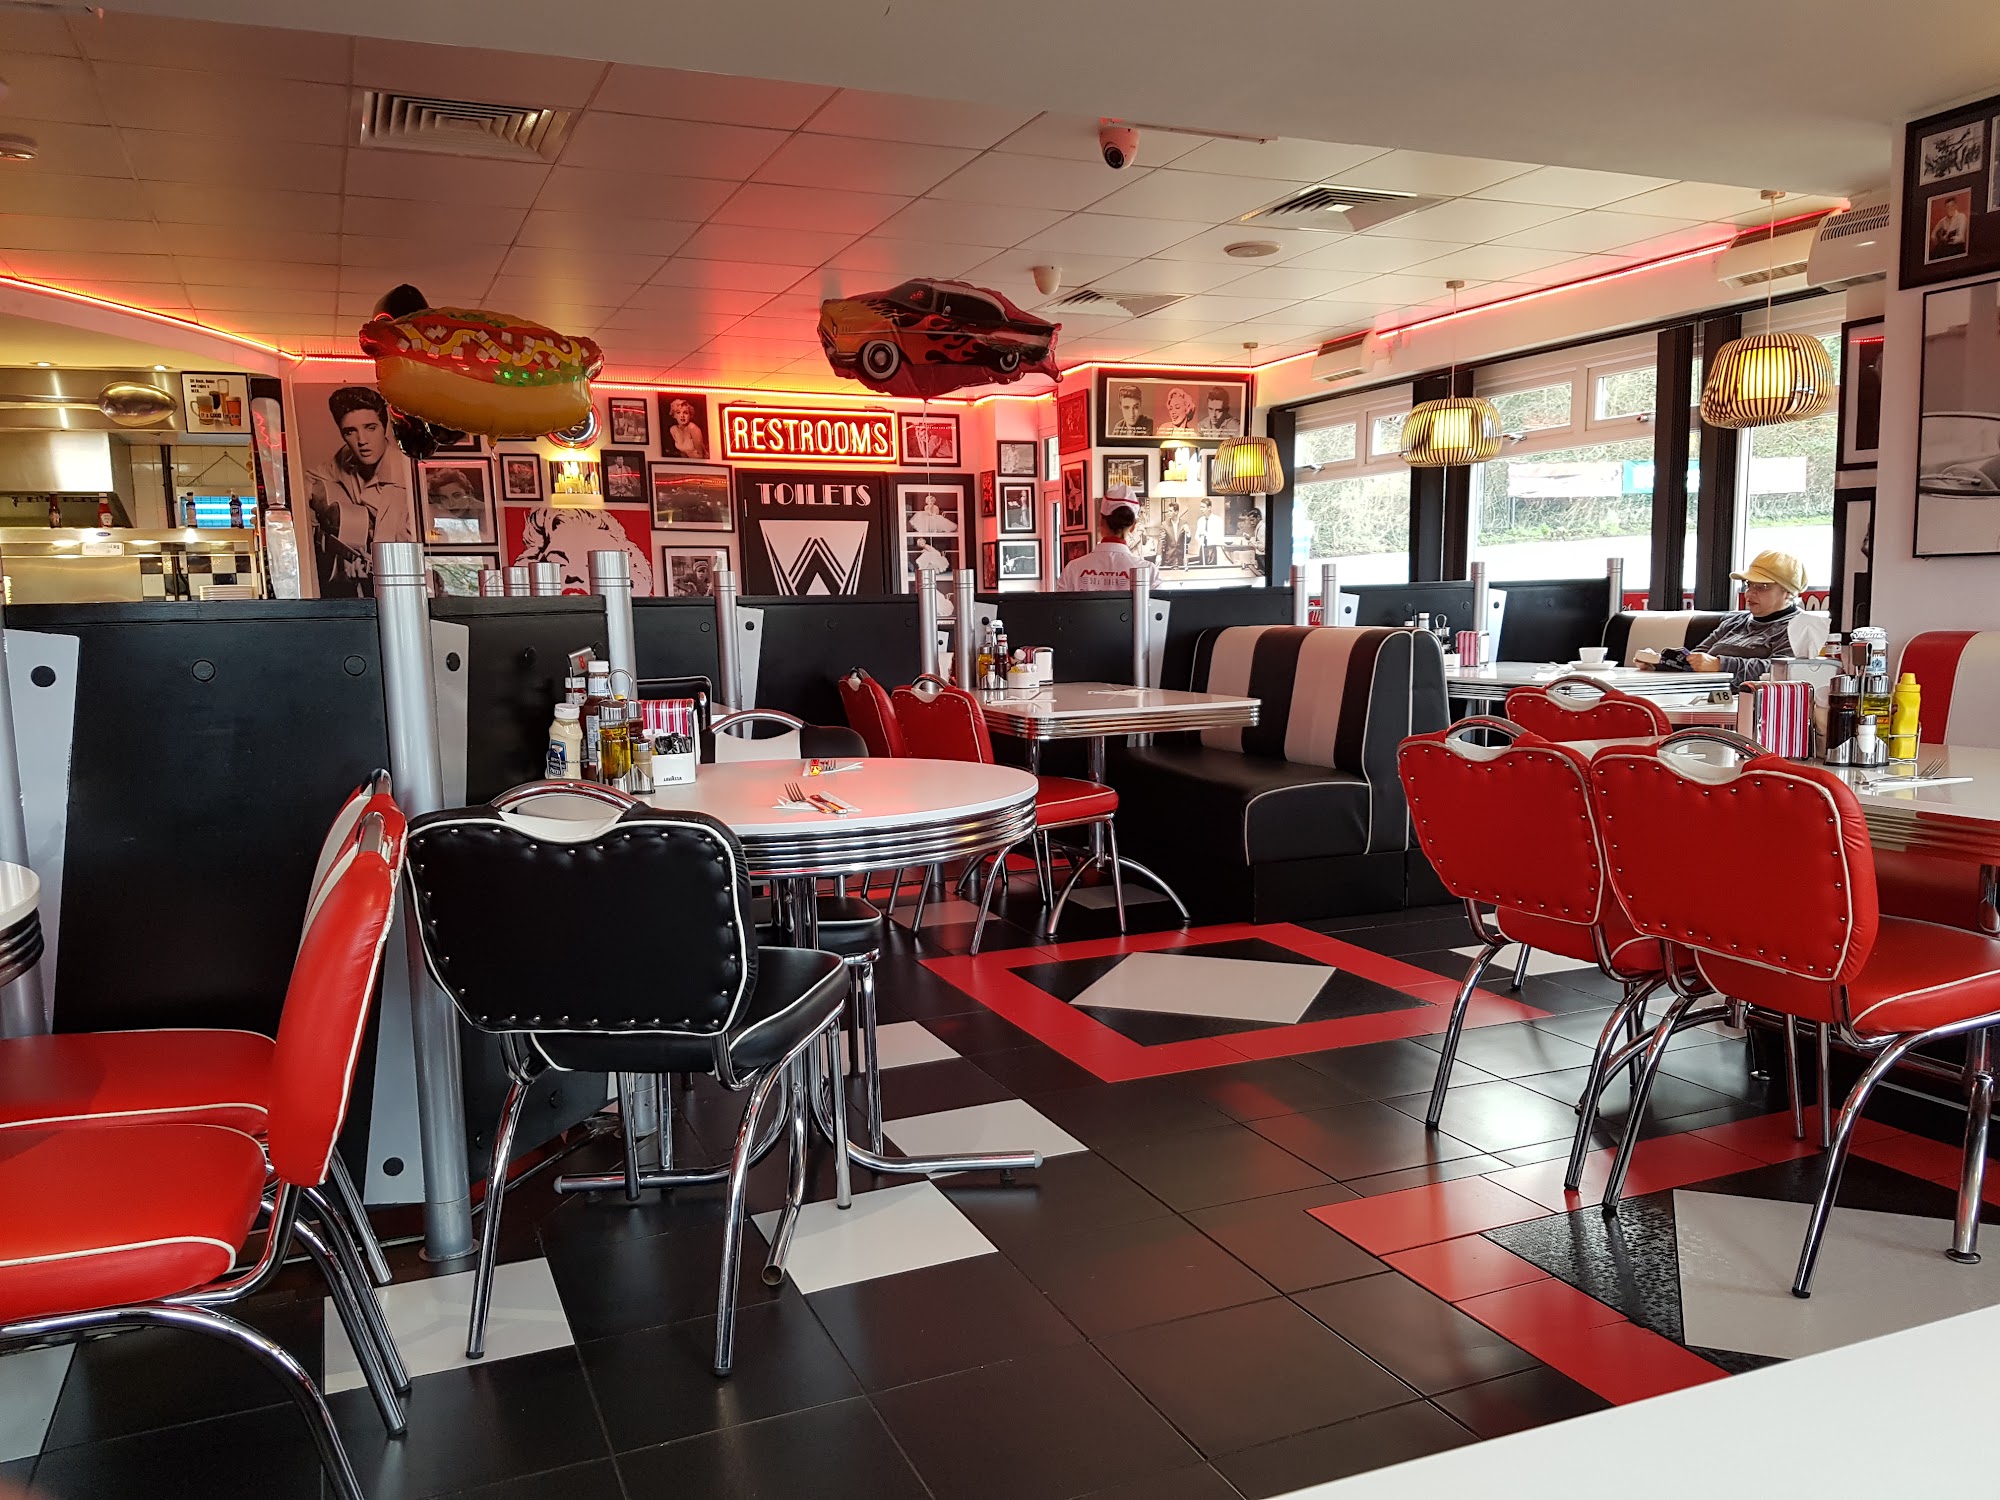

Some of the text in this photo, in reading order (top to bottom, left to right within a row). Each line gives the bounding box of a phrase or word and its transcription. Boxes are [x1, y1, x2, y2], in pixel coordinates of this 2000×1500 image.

[734, 416, 889, 455] RESTROOMS
[755, 482, 871, 507] TOILETS
[1079, 569, 1130, 579] MATTIA
[578, 655, 585, 670] 8
[1716, 691, 1730, 701] 18
